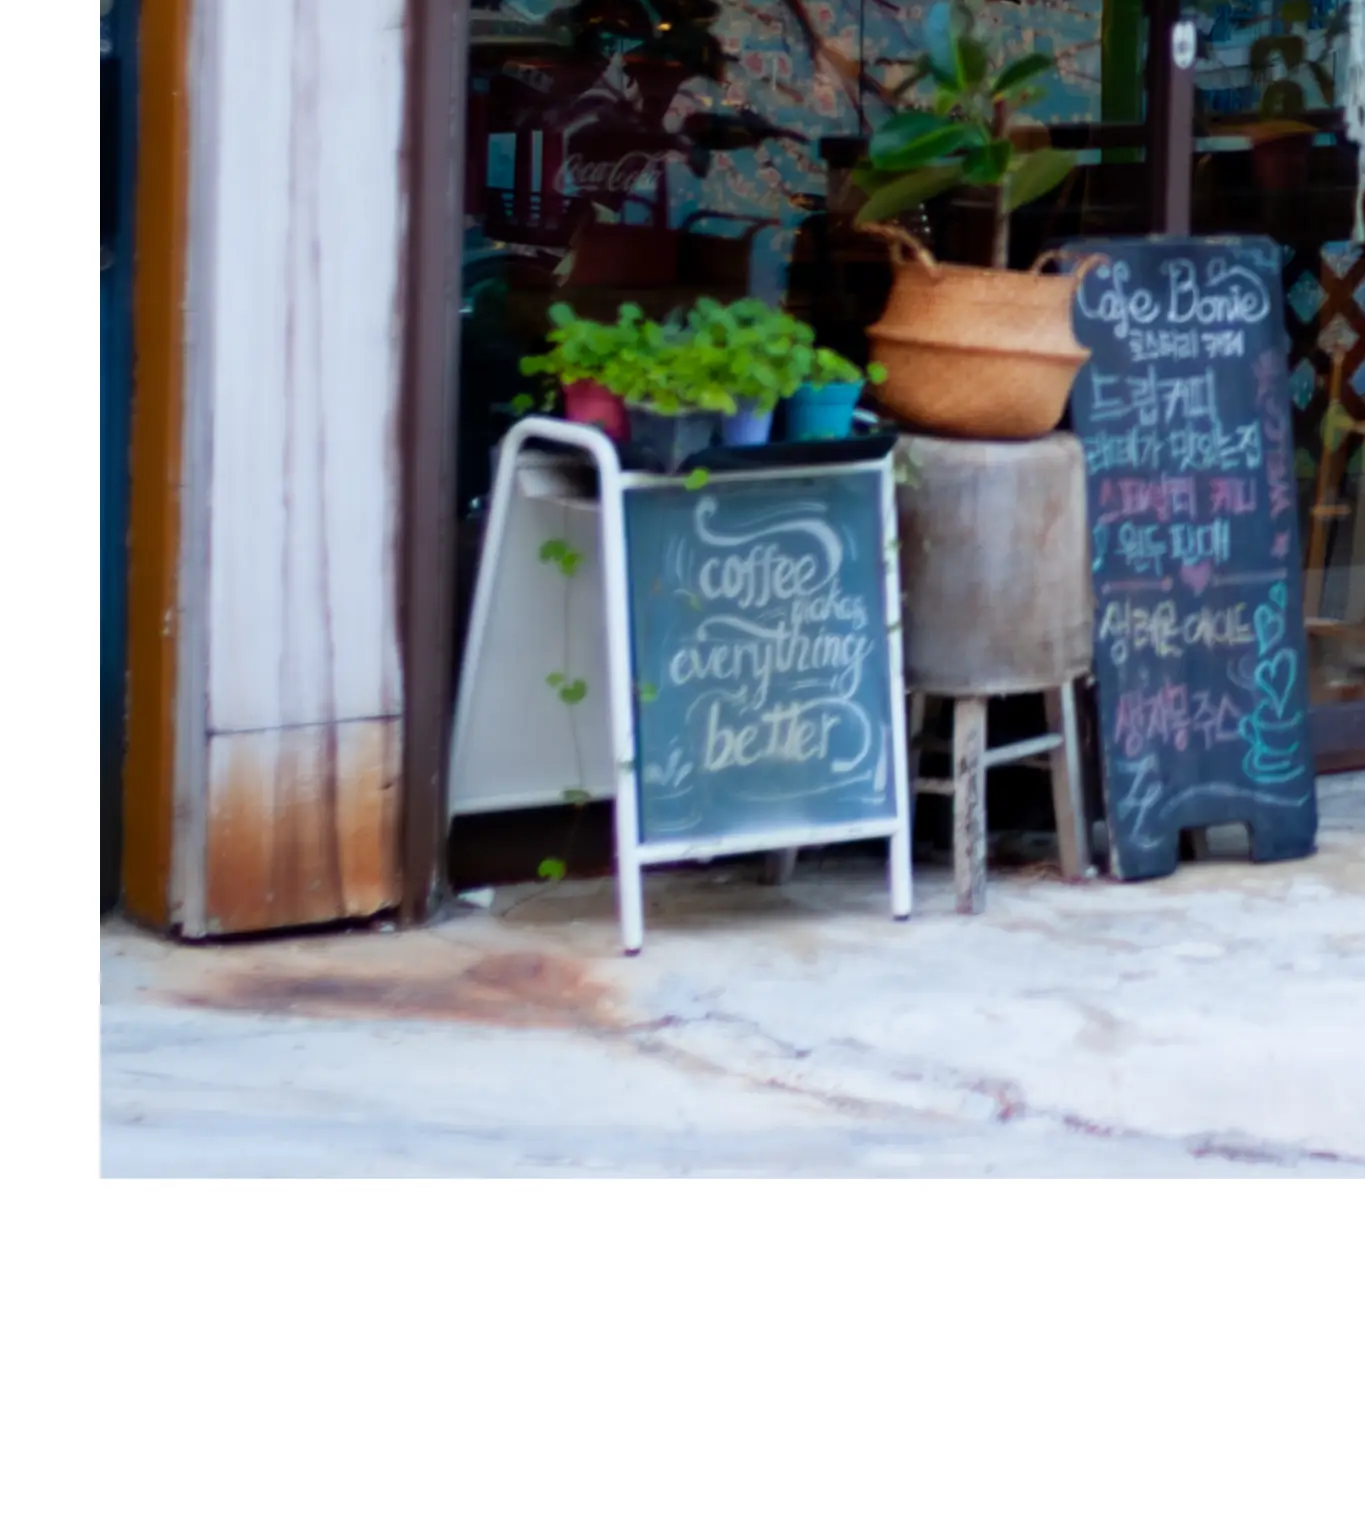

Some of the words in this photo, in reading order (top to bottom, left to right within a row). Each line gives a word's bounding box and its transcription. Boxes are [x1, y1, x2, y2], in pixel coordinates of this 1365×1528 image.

[1076, 260, 1160, 339] Cafe
[699, 541, 824, 609] coffee
[669, 620, 875, 712] everything
[703, 699, 842, 773] better
